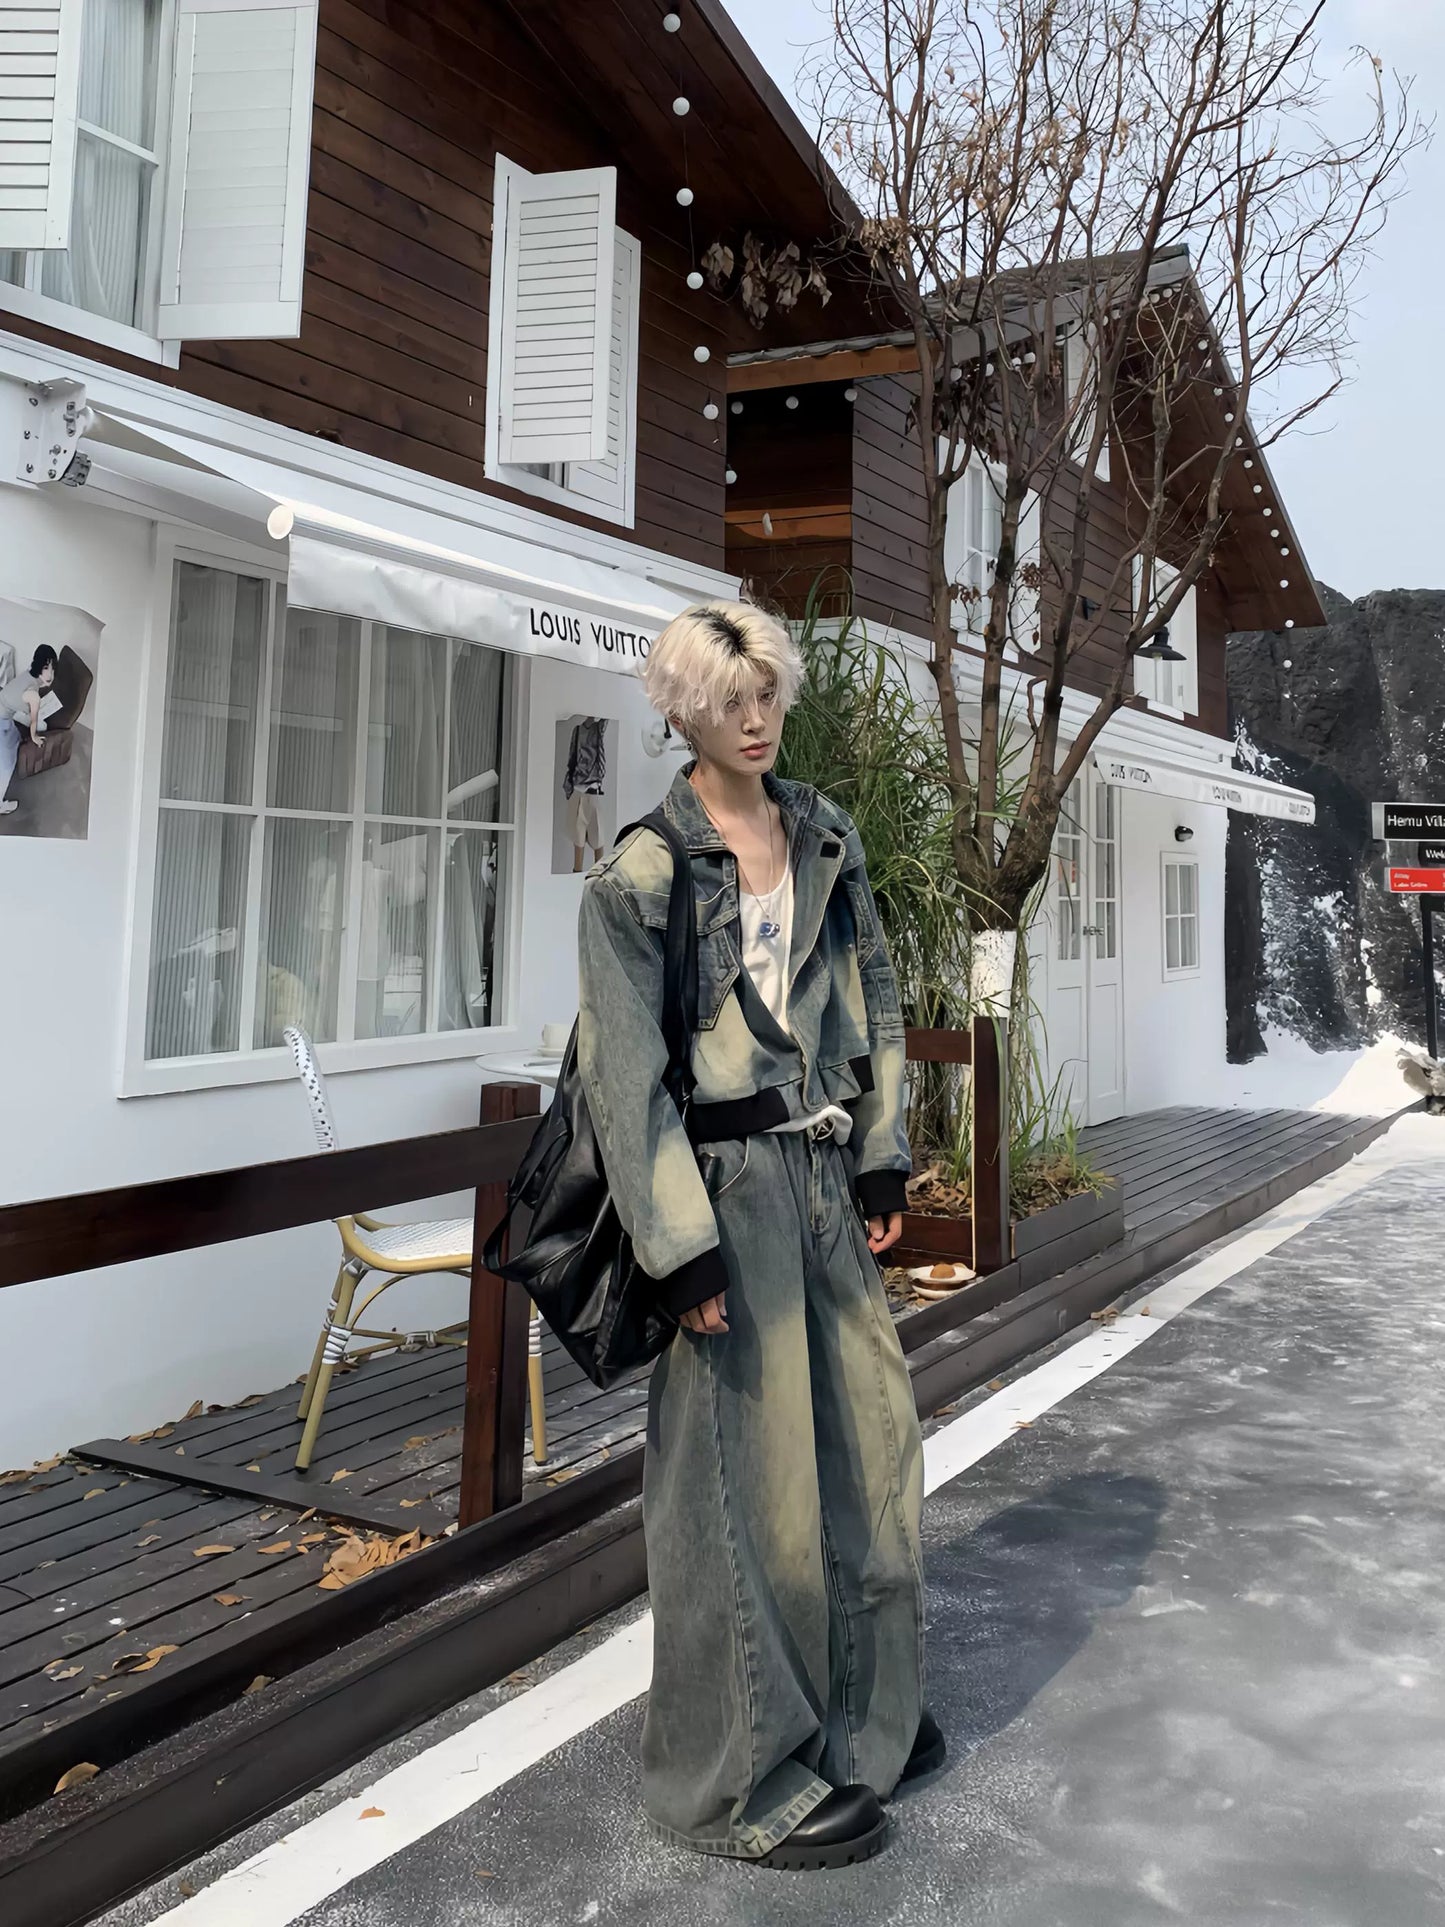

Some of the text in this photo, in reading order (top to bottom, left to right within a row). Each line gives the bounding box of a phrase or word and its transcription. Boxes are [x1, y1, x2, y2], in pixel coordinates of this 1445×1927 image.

[530, 608, 653, 658] LOUIS VUITTO
[1387, 814, 1423, 827] Hemu
